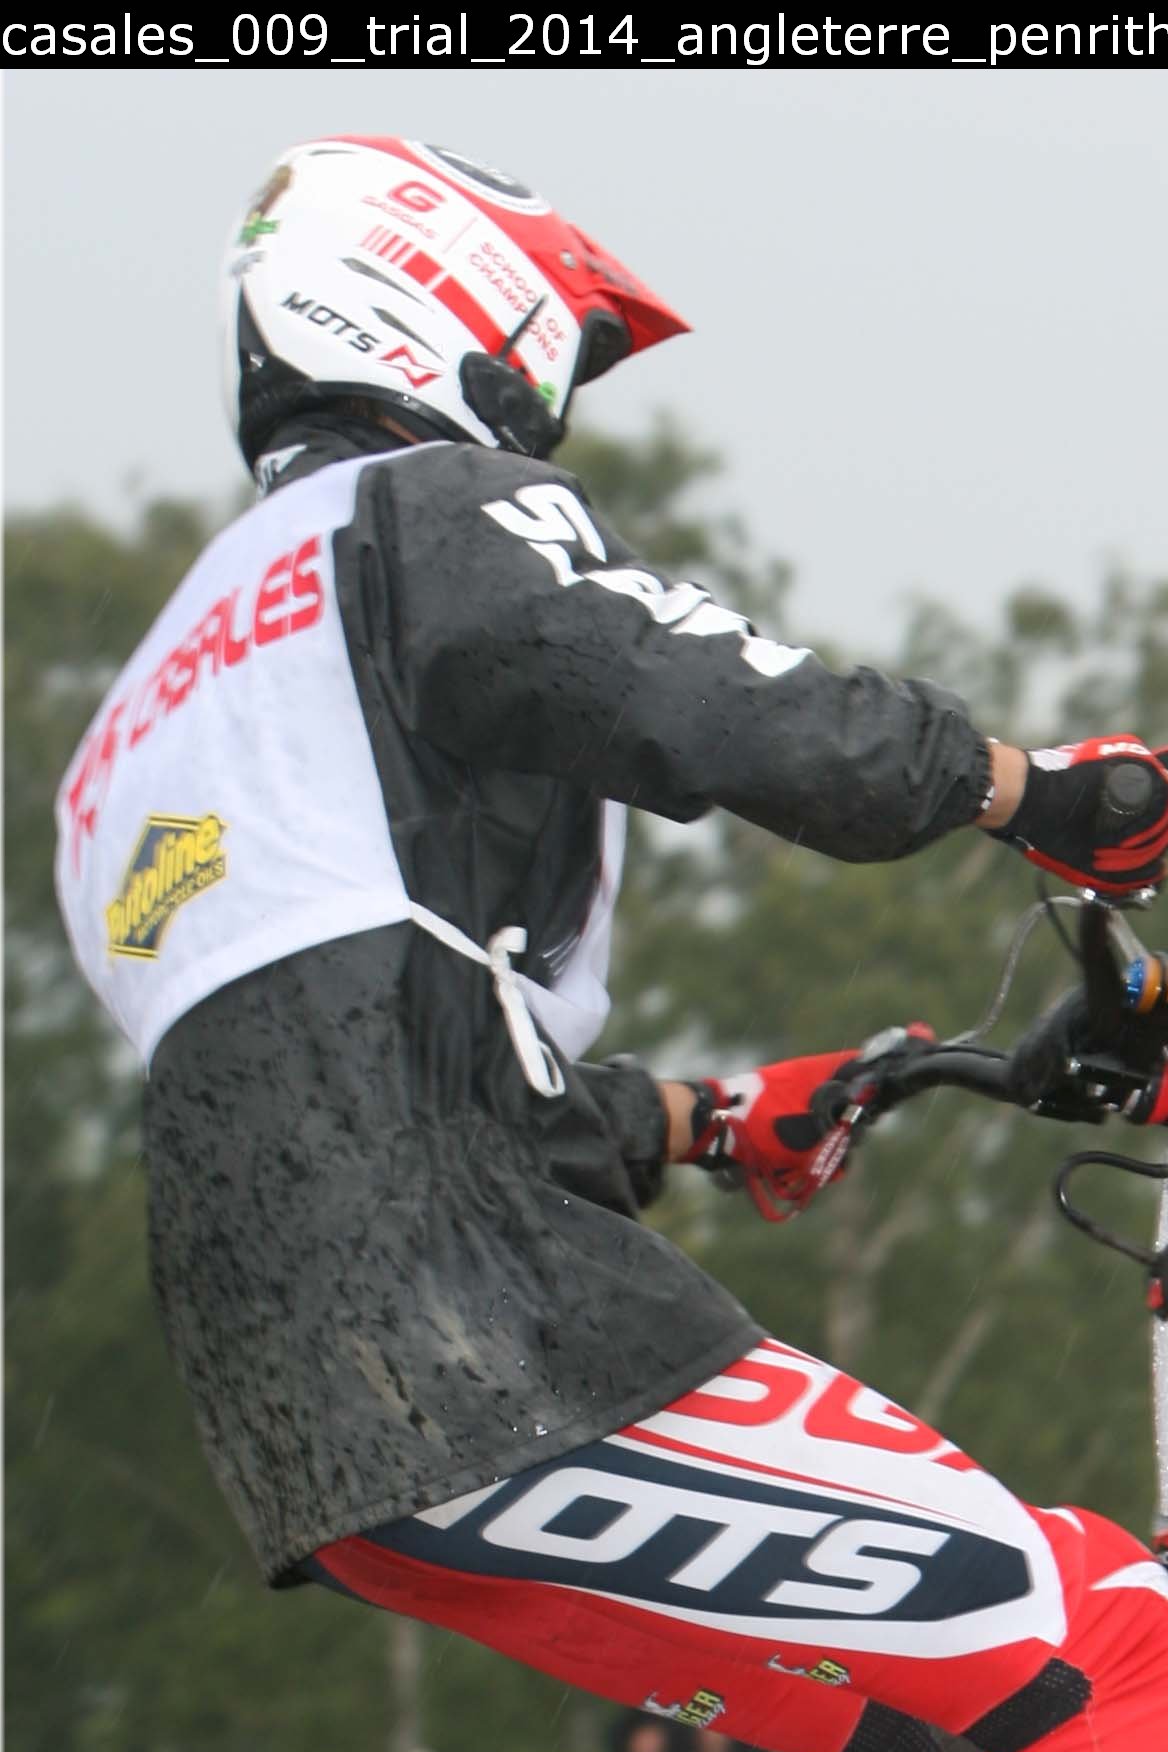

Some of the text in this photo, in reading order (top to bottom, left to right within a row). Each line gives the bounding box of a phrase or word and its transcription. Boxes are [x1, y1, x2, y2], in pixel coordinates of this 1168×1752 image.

[469, 253, 561, 362] CHAMPONS
[480, 241, 541, 304] SCHOO
[282, 292, 382, 353] MOTS
[413, 1467, 951, 1616] OTS
